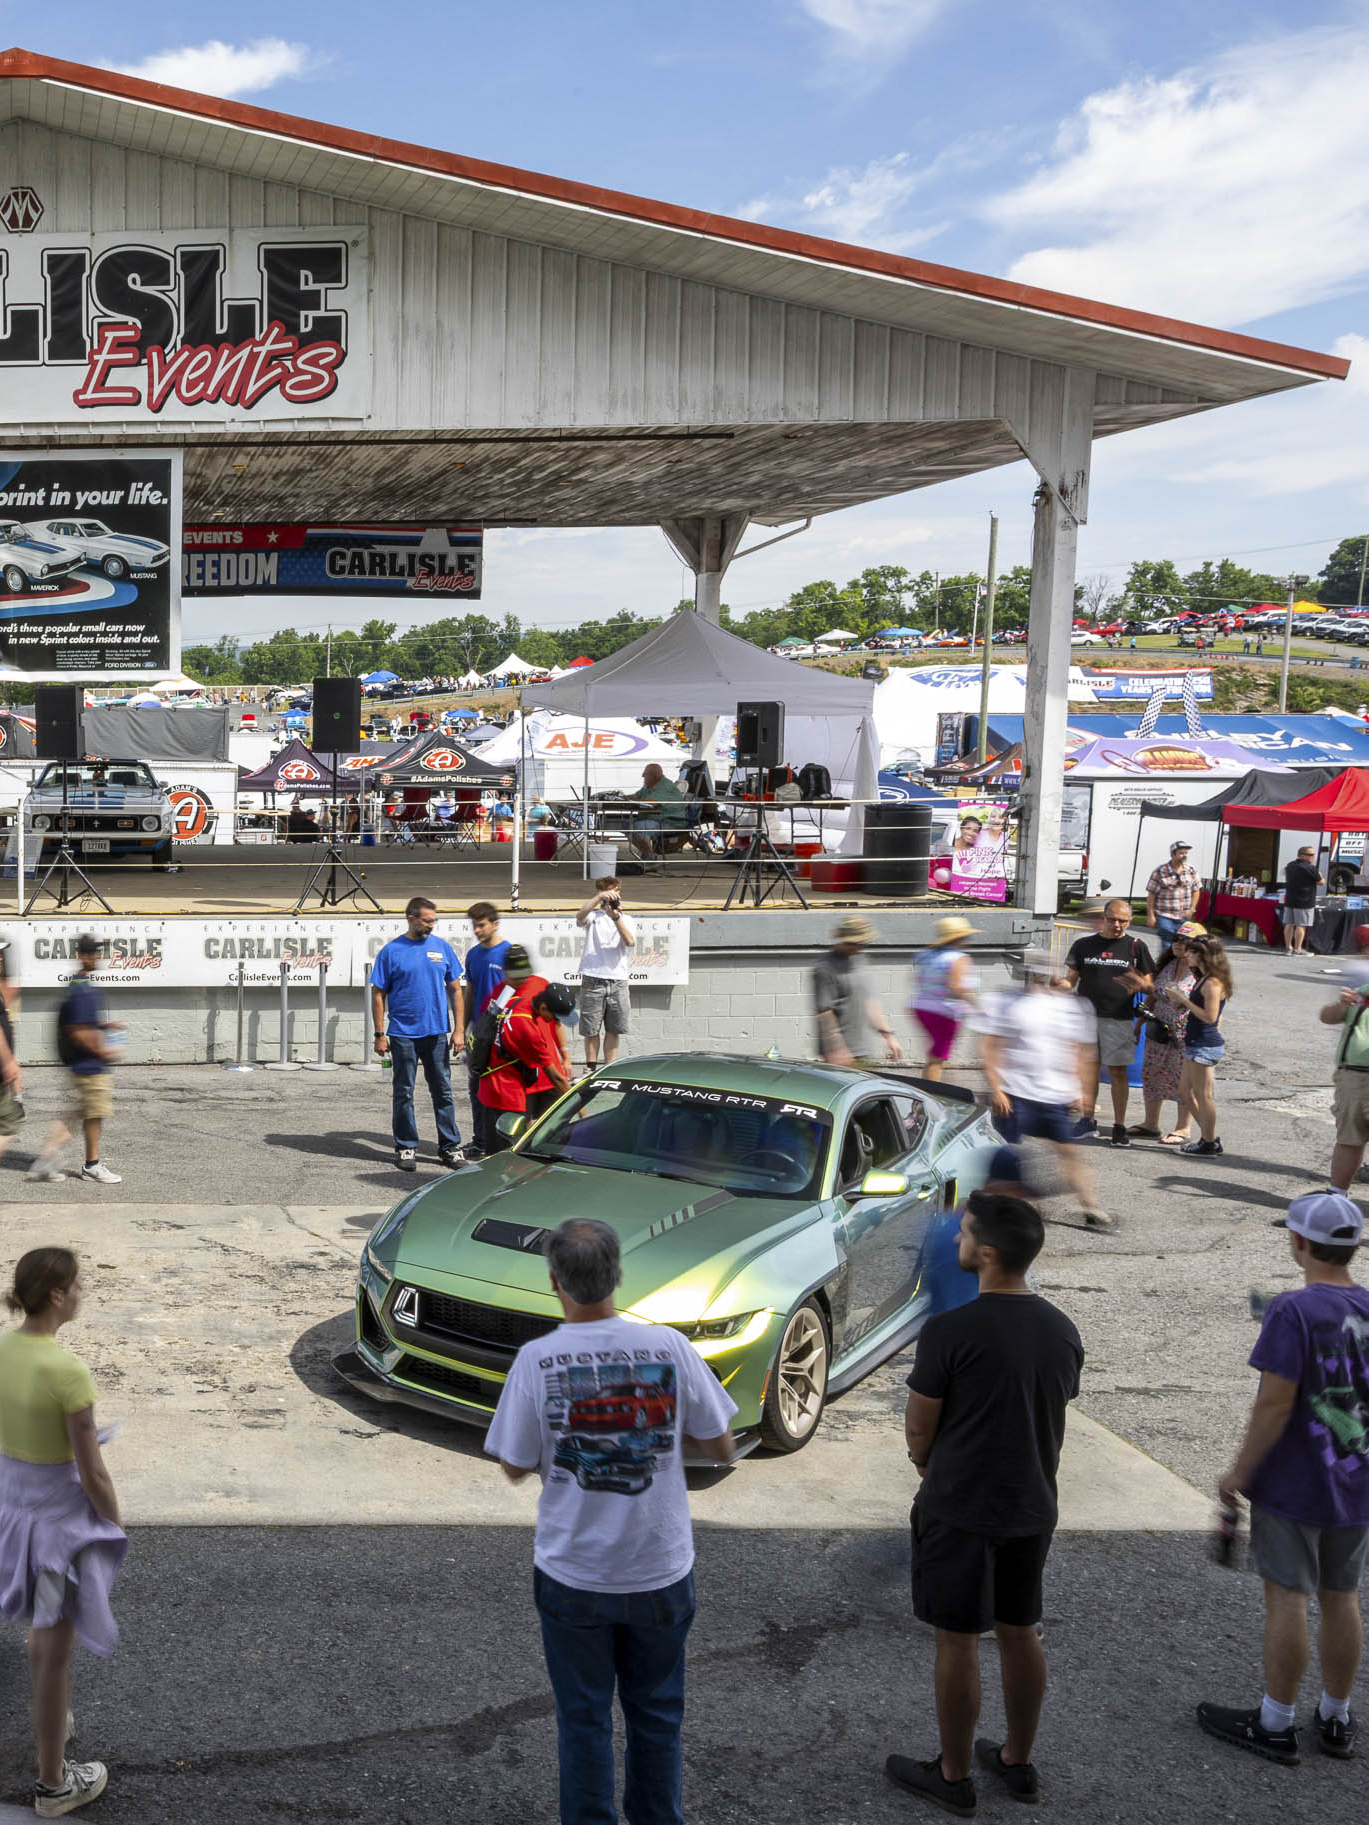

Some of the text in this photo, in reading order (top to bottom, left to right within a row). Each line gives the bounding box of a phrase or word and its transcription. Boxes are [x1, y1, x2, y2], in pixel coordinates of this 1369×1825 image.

[73, 320, 344, 413] Events
[49, 482, 71, 506] in
[74, 487, 122, 511] your
[128, 482, 169, 505] life.
[183, 530, 244, 545] EVENTS
[328, 549, 476, 578] CARLISLE
[130, 572, 158, 580] MUSTANG
[412, 568, 476, 590] Events
[31, 584, 60, 592] MAVERICK
[19, 622, 44, 633] three
[45, 622, 81, 636] popular
[81, 622, 105, 633] small
[106, 624, 124, 633] cars
[125, 624, 146, 632] now
[8, 633, 161, 646] in new Sprint colors inside and out.
[545, 732, 616, 749] AJE
[411, 775, 483, 784] #AdamsPolishes
[171, 784, 198, 793] ADAM'S
[969, 847, 994, 857] PINK
[33, 925, 166, 933] EXPERIENCE
[34, 938, 162, 960] CARISLE
[204, 937, 333, 959] CARLISLE
[108, 951, 163, 970] Events
[228, 973, 312, 981] CalisleEves.com
[631, 1083, 768, 1109] MUSTANG RTR
